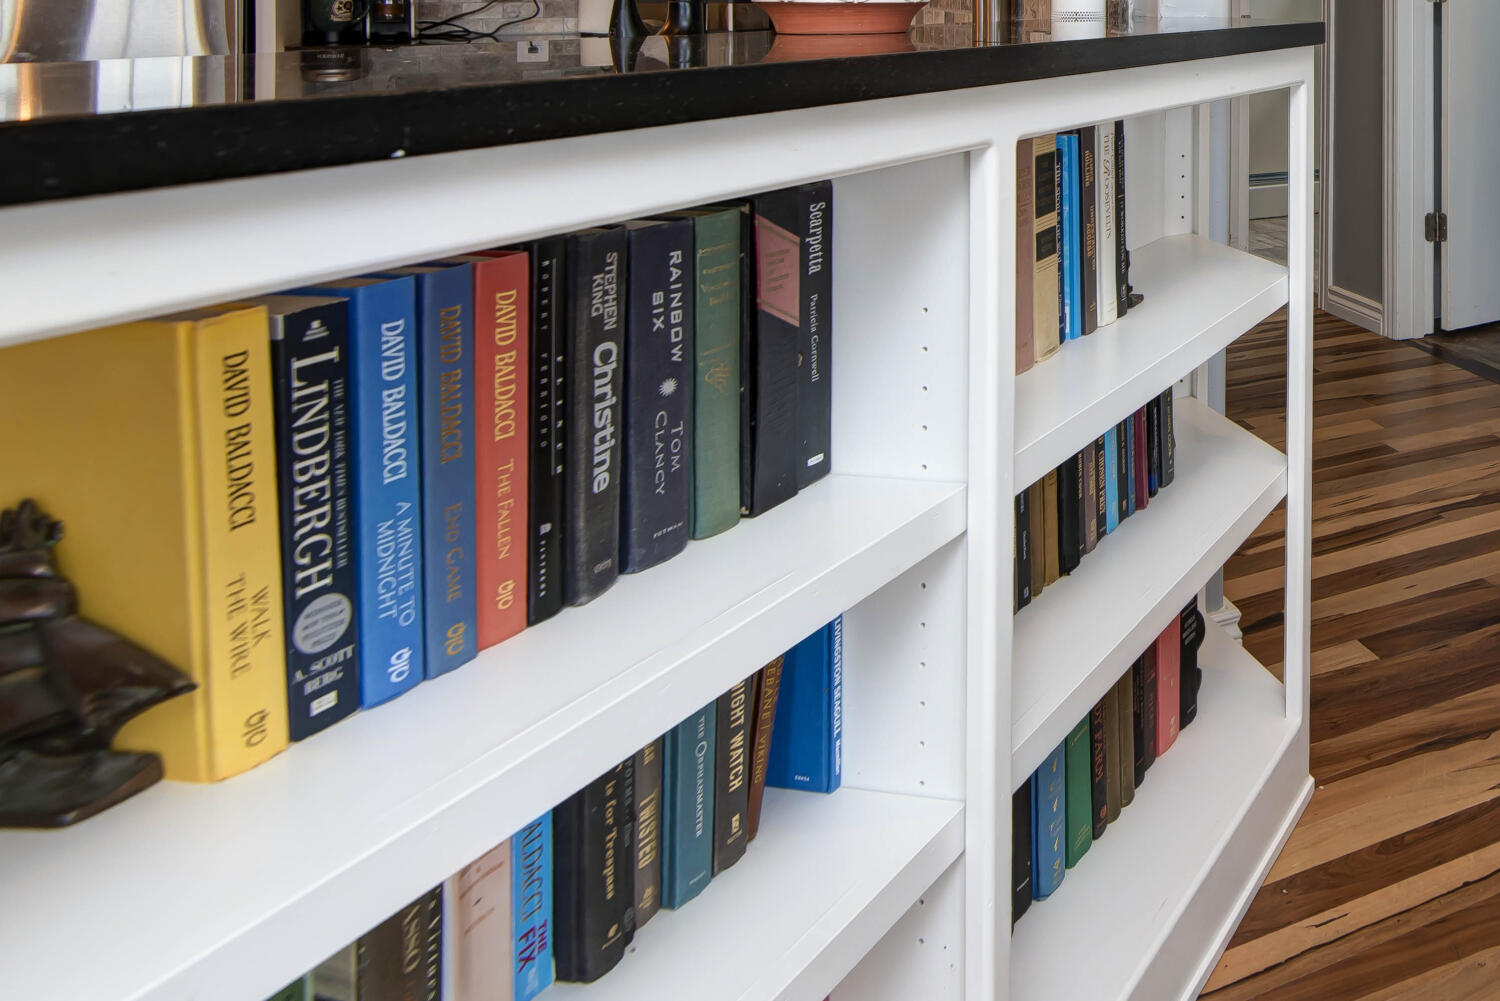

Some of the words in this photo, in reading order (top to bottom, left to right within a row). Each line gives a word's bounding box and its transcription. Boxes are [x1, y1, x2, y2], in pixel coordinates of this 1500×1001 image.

[1102, 159, 1112, 240] ROOSEVELTS
[804, 202, 826, 275] Scarpetta
[494, 288, 517, 348] DAVID
[540, 259, 550, 333] ROBERT
[591, 272, 604, 318] KING
[603, 251, 618, 332] STEPHEN
[652, 291, 664, 332] SIX
[668, 250, 684, 364] RAINBOW
[809, 293, 819, 333] Patricia
[380, 319, 407, 381] DAVID
[439, 304, 462, 365] DAVID
[810, 335, 820, 383] Cornwell
[221, 350, 251, 419] DAVID
[494, 349, 517, 443] BALDACCI
[540, 352, 550, 450] FERRIGNO
[333, 431, 346, 458] YORK
[381, 385, 409, 486] BALDACCI
[440, 369, 462, 466] BALDACCI
[592, 339, 619, 495] Christine
[668, 420, 684, 474] TOM
[224, 424, 256, 532] BALDACCI
[290, 346, 341, 601] LINDBERGH
[497, 458, 515, 492] THE
[655, 411, 668, 497] CLANCY
[1097, 450, 1105, 490] CHOSEN
[398, 500, 410, 517] A
[444, 502, 461, 540] END
[496, 494, 515, 561] FALLEN
[376, 520, 399, 621] MIDNIGHT
[398, 519, 416, 589] MINUTE
[445, 546, 462, 604] GAME
[224, 573, 245, 620] THE
[249, 585, 272, 646] WALK
[399, 596, 416, 627] TO
[228, 623, 252, 681] WIRE
[304, 666, 344, 696] BERG
[310, 644, 356, 672] SCOTT
[833, 618, 842, 685] LIVINGSTON
[696, 715, 706, 739] THE
[833, 687, 842, 738] SEAGULL
[728, 730, 745, 792] WATCH
[754, 734, 768, 785] VIKING
[1094, 728, 1104, 783] FARM
[605, 800, 617, 825] for
[694, 741, 708, 839] ORPHANMASTER
[638, 788, 658, 870] TWISTED
[520, 820, 543, 924] ALDACCI
[602, 826, 617, 900] Trespass
[517, 926, 537, 974] FIX
[536, 919, 548, 956] THE
